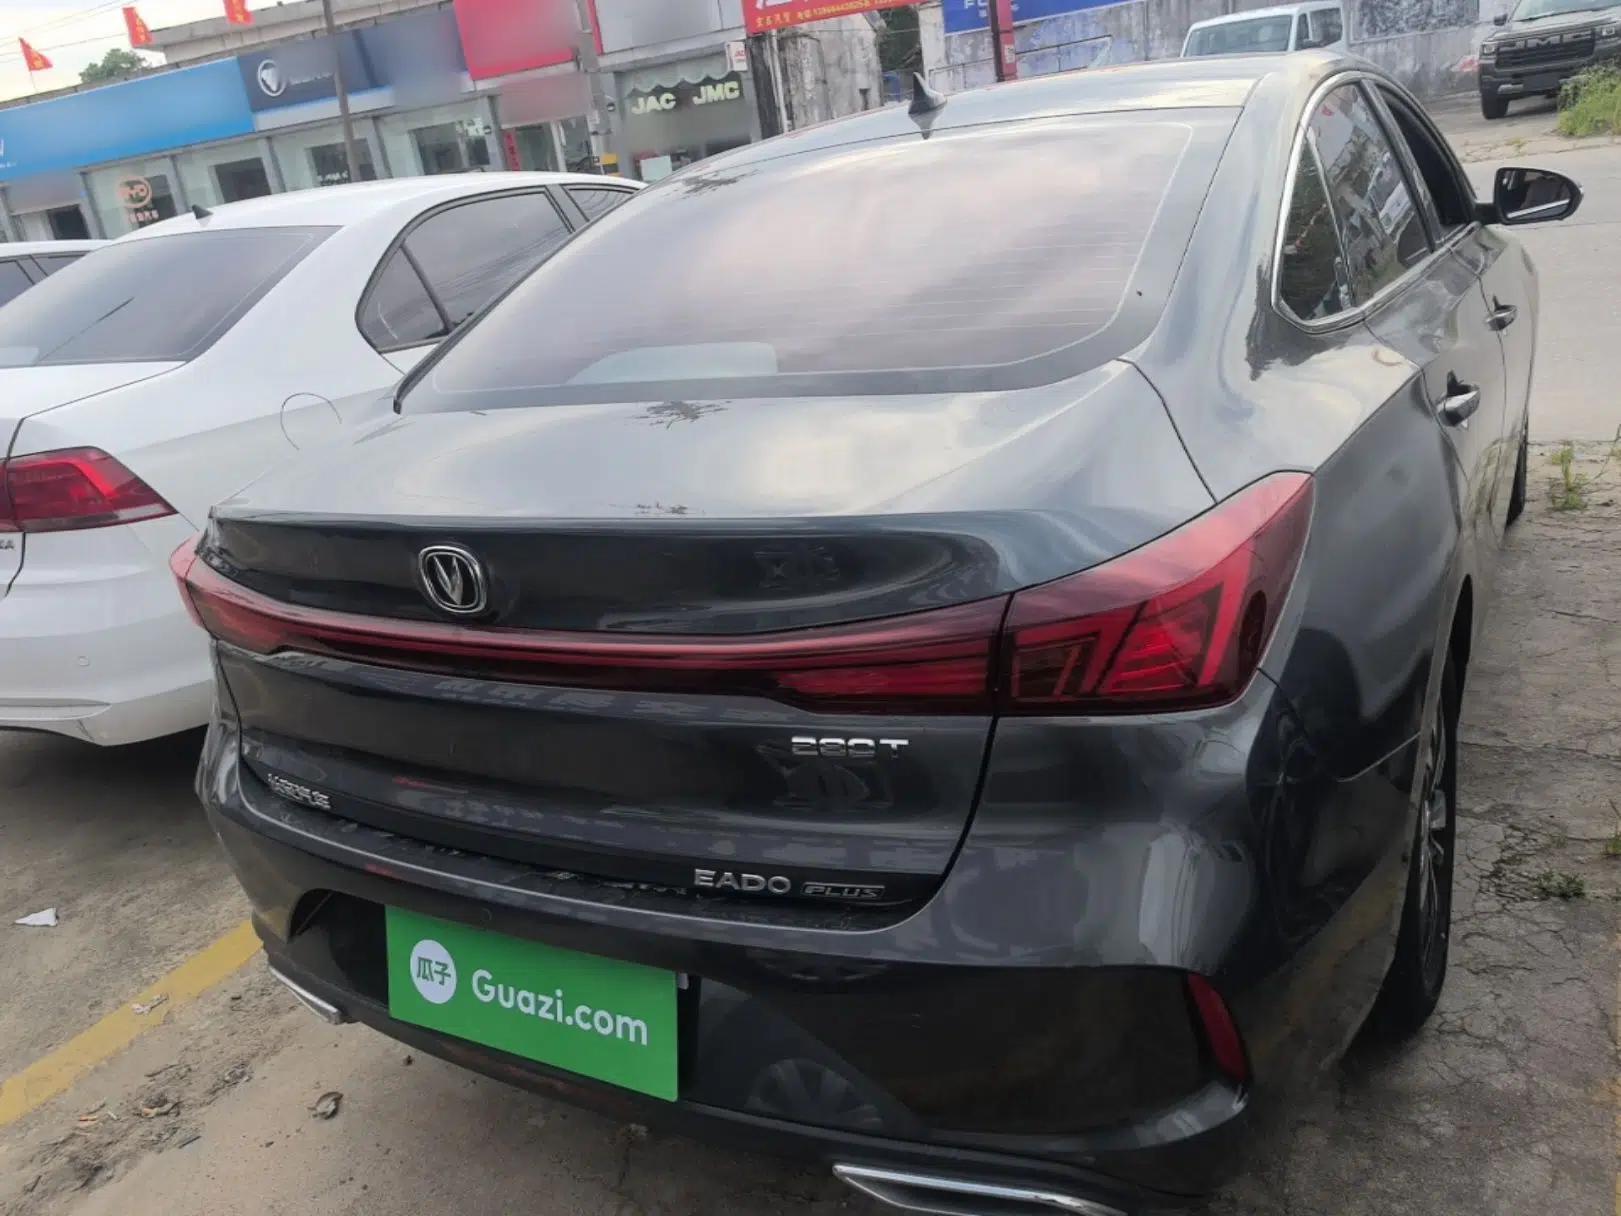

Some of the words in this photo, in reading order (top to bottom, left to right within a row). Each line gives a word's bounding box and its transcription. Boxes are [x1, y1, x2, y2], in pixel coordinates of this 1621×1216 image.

[631, 92, 677, 115] JAC
[692, 81, 740, 105] JMC
[694, 868, 792, 894] EADO
